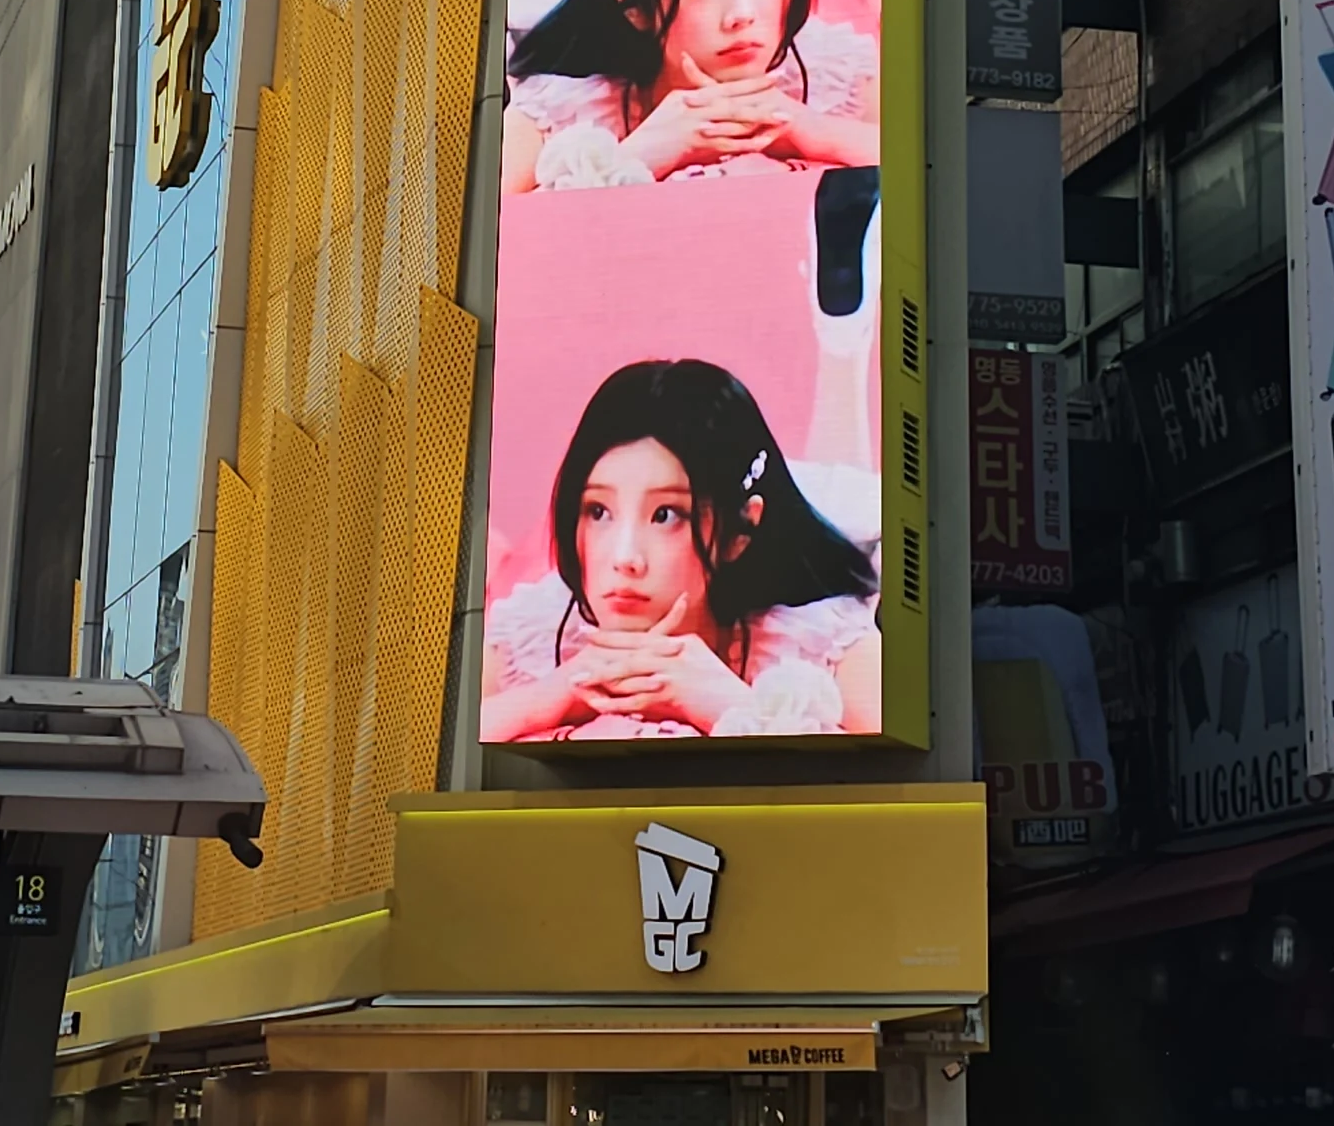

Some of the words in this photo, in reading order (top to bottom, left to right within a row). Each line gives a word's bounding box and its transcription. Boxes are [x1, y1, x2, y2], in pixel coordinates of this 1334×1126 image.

[975, 356, 1021, 385] 명동
[976, 388, 1025, 549] 스타사
[970, 562, 1064, 585] 777-4203
[981, 761, 1107, 814] PUB
[1180, 747, 1301, 828] LUGGAGE
[15, 875, 45, 901] 18
[749, 1048, 790, 1065] MEGA
[804, 1048, 845, 1064] COFFEE
